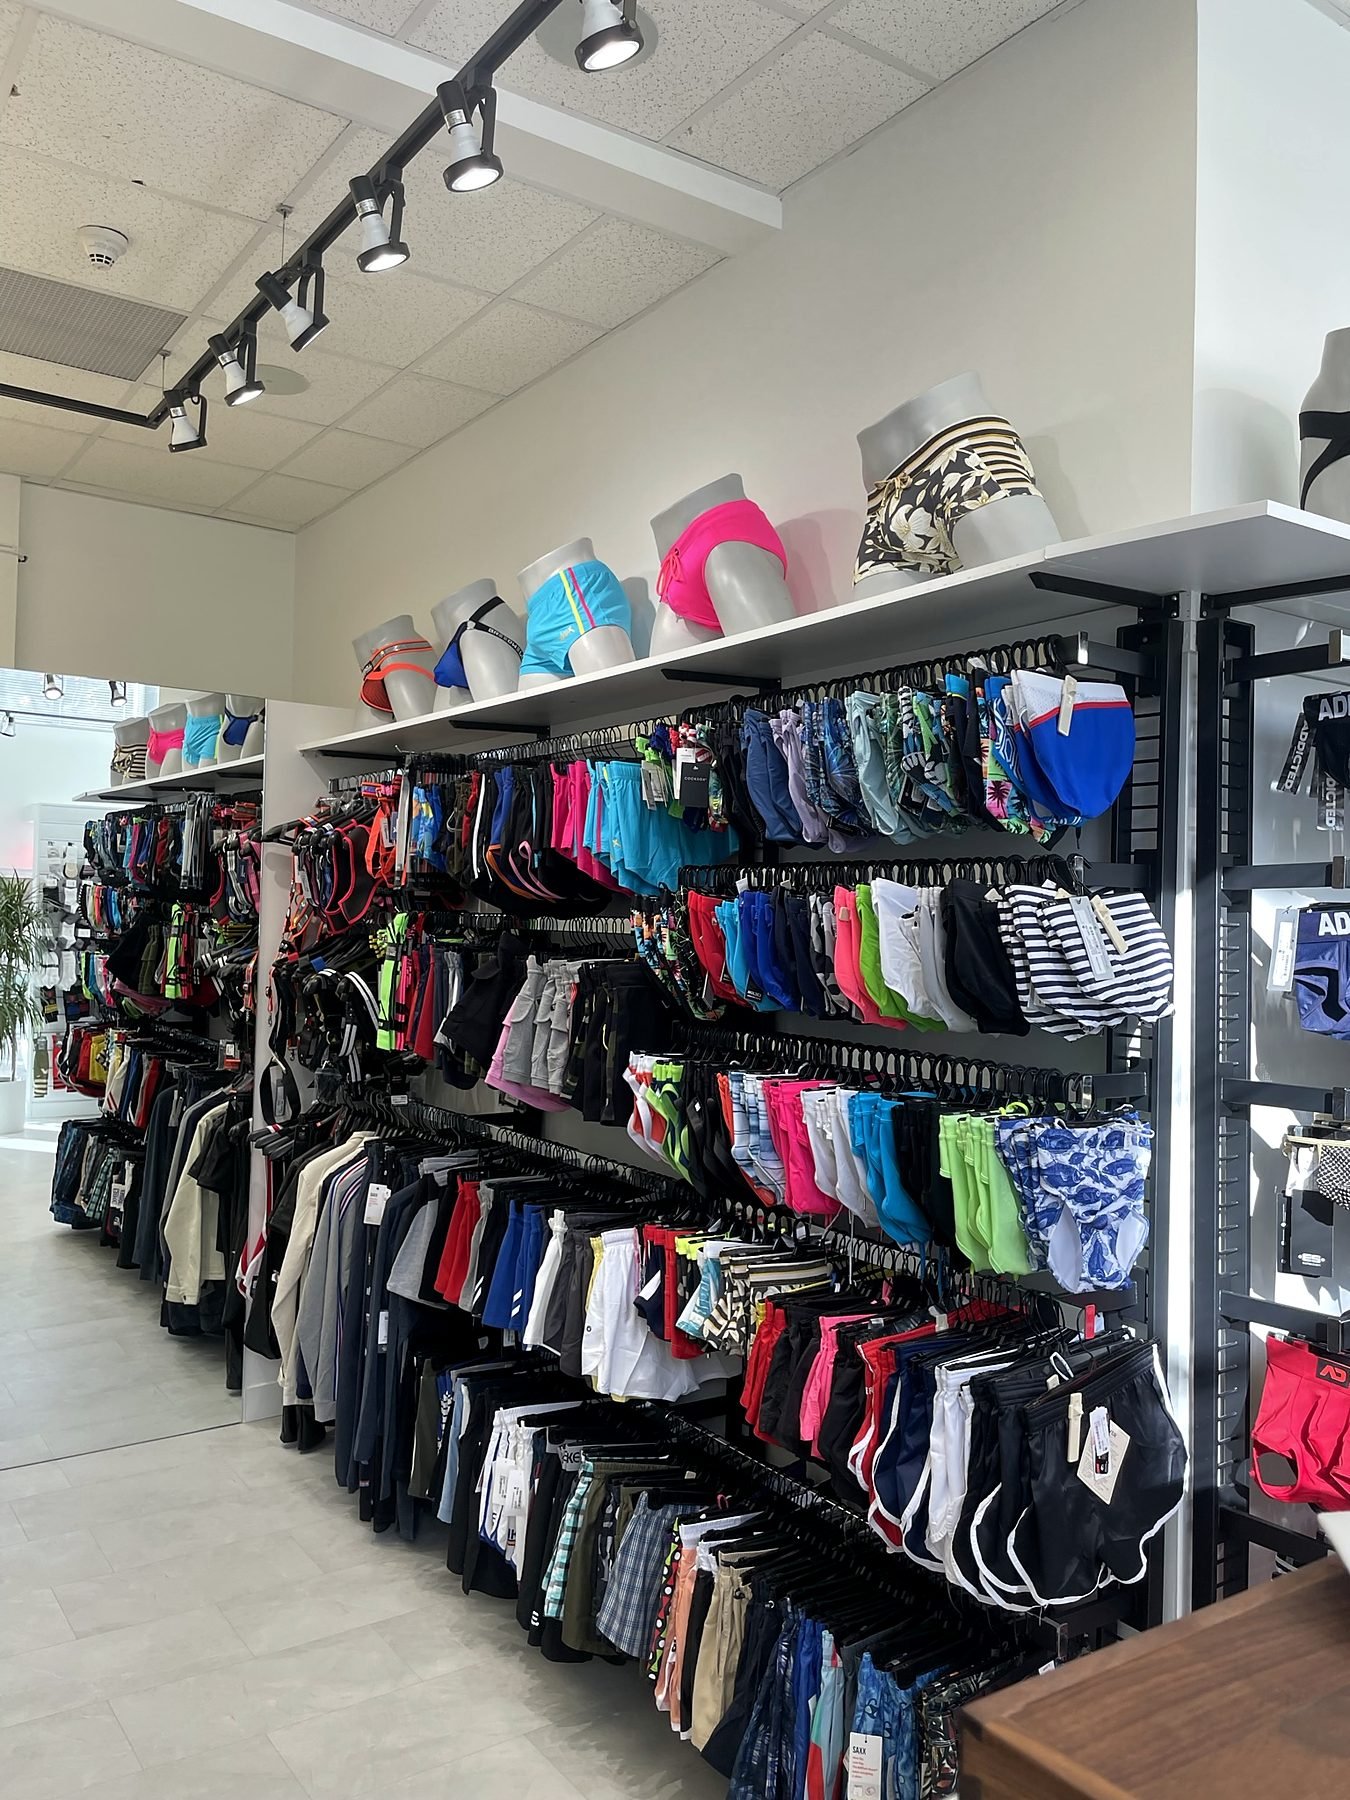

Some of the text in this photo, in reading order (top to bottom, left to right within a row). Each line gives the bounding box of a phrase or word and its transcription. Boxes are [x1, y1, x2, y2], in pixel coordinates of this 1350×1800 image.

[1318, 695, 1350, 721] AD
[1284, 719, 1309, 790] ADDICTED
[1325, 777, 1337, 827] DICTED
[1318, 911, 1350, 936] AD
[852, 1745, 867, 1755] SAXX
